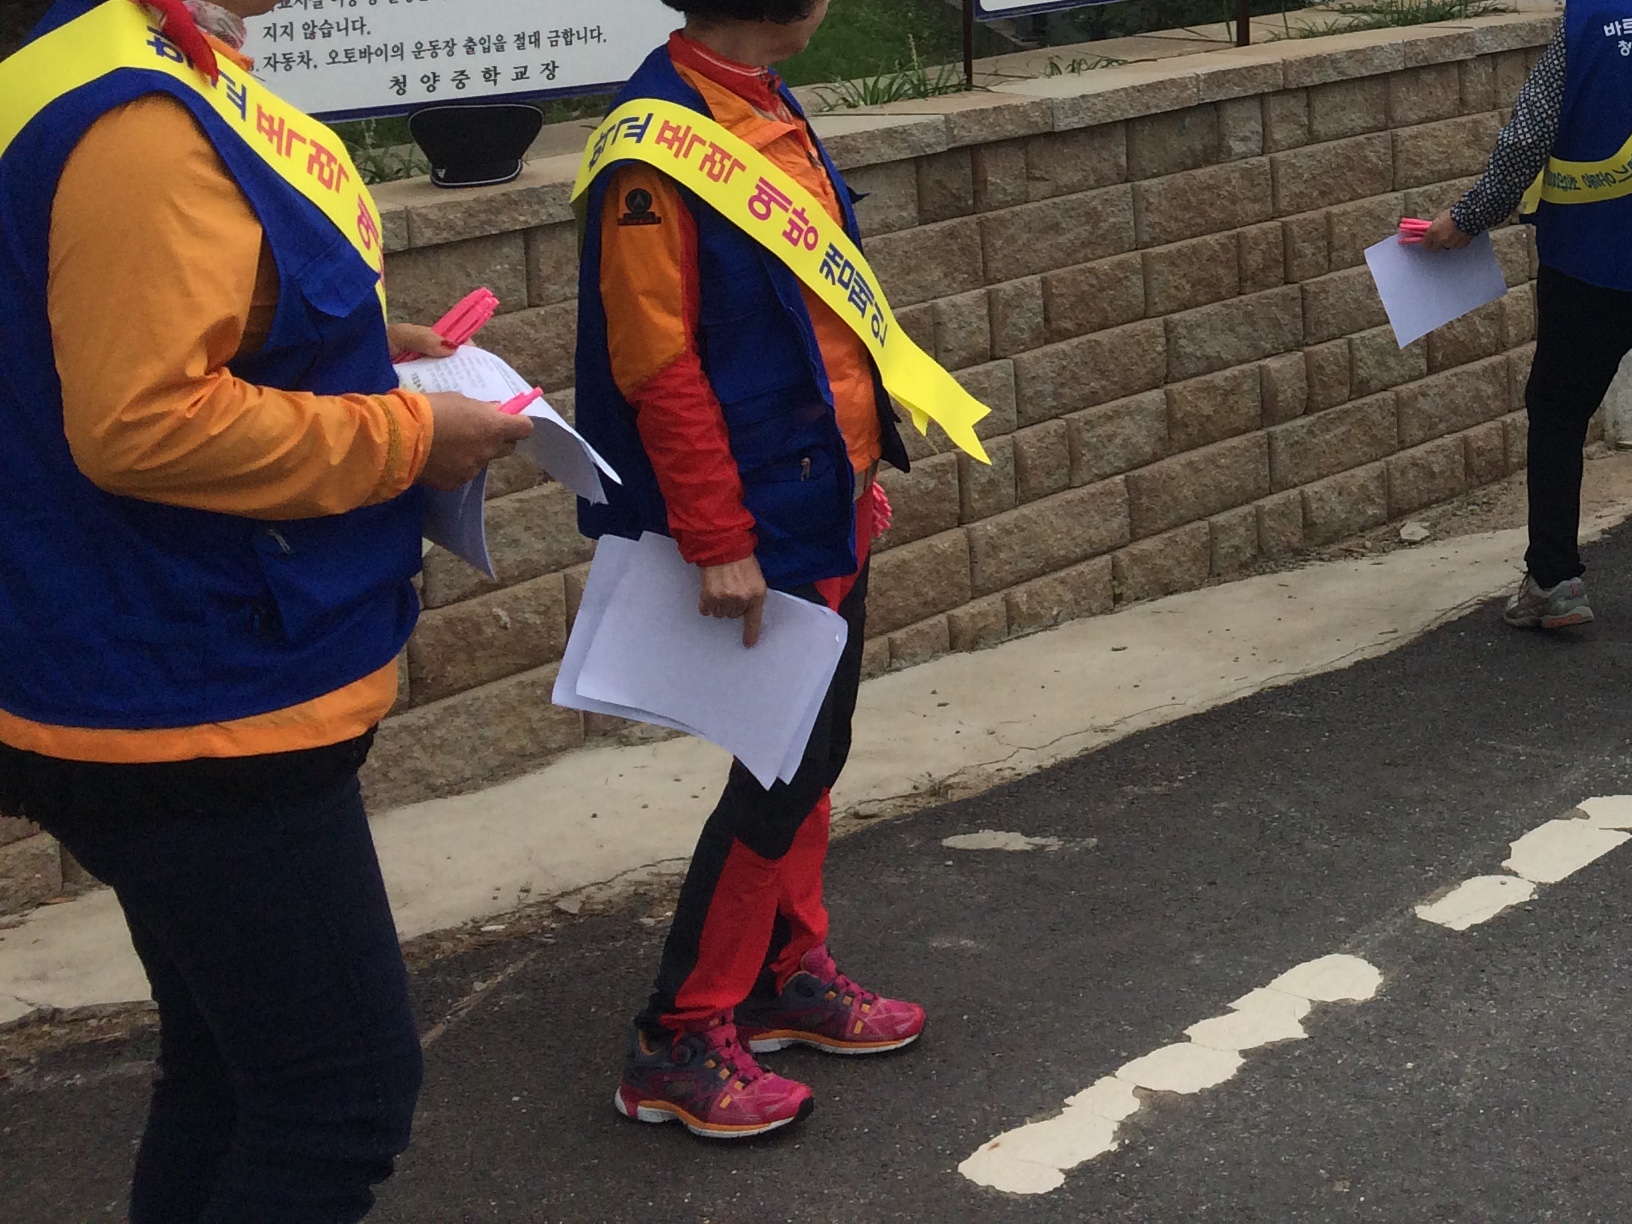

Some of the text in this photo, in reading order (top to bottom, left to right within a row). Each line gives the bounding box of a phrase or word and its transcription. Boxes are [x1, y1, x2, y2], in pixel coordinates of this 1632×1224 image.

[262, 16, 371, 43] 지지 않습니다.
[325, 41, 405, 66] 오토바이의
[411, 37, 457, 59] 운동장
[462, 34, 507, 55] 출입을
[513, 30, 541, 50] 절대
[546, 25, 608, 48] 금합니다.
[747, 176, 819, 252] 예방
[818, 241, 888, 348] 캠페인
